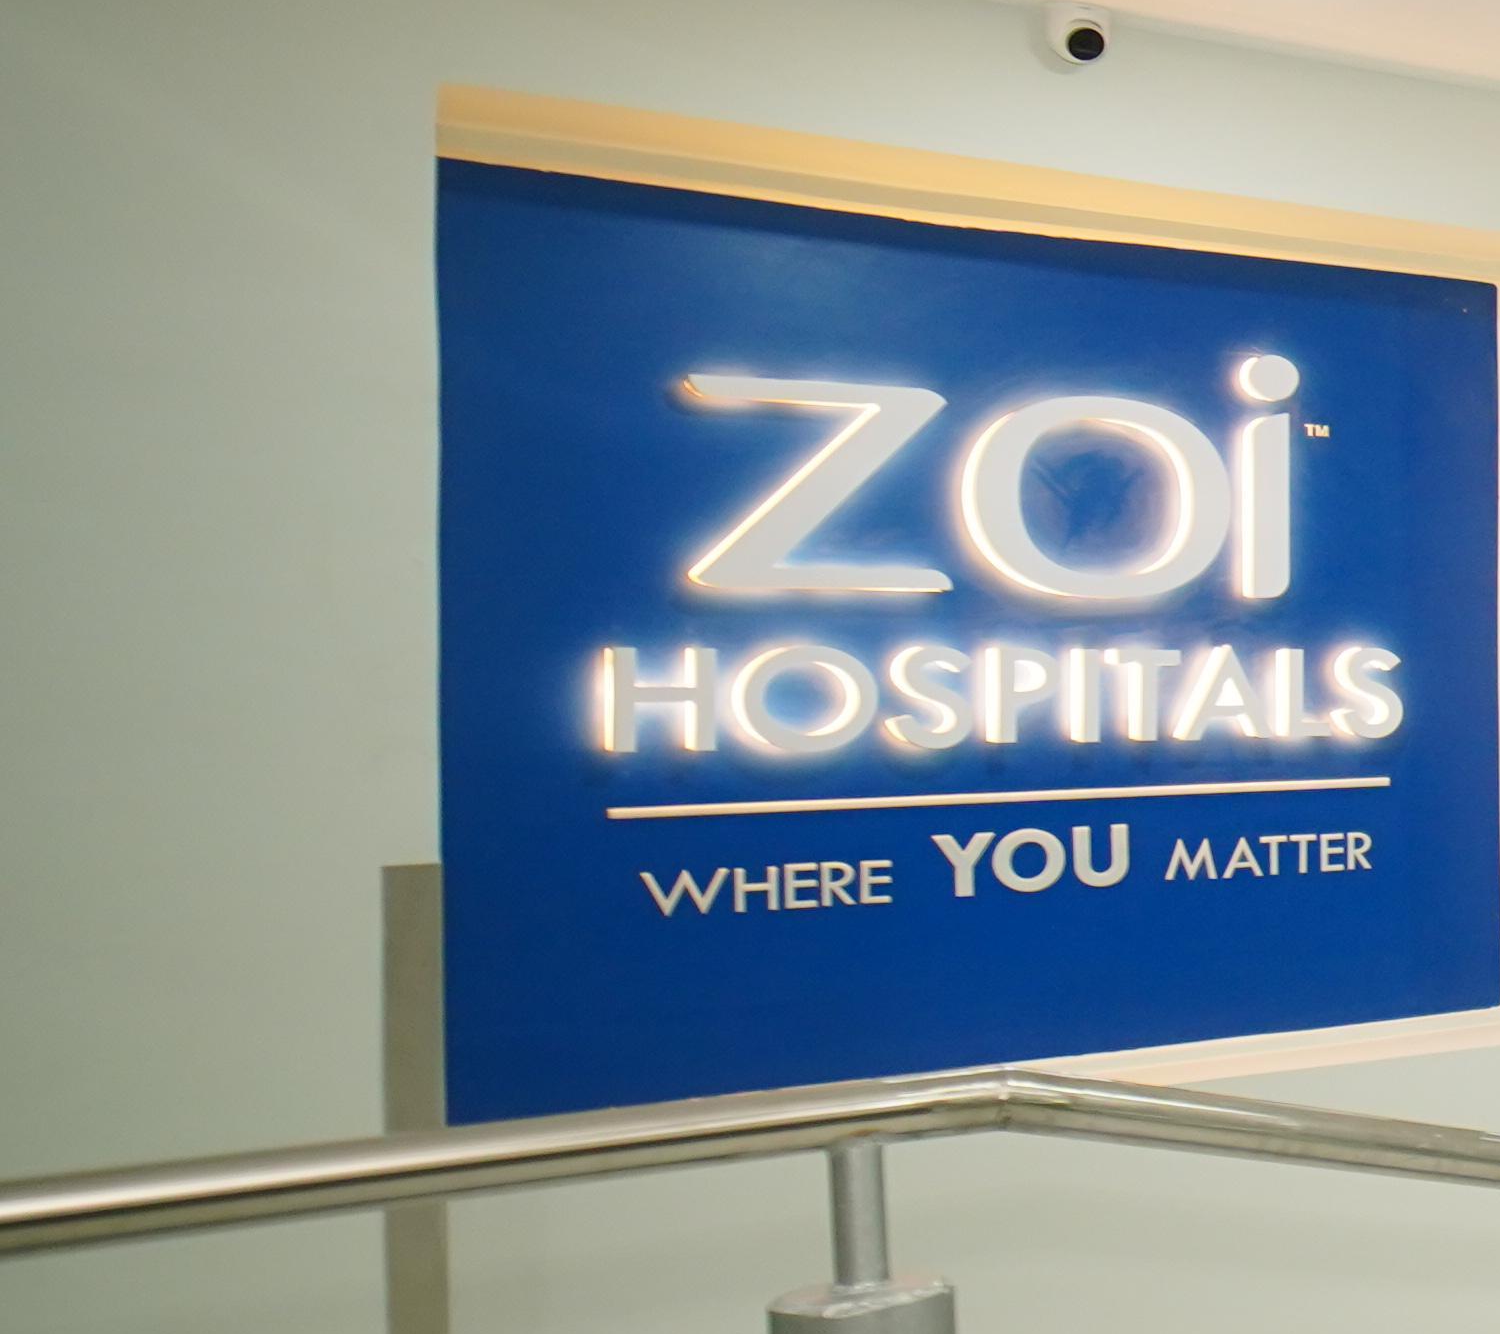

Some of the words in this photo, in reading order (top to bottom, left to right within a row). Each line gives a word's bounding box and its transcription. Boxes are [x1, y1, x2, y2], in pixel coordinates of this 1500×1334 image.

[603, 645, 1404, 753] HOSPITALS
[640, 859, 893, 917] WHERE
[931, 823, 1130, 898] YOU
[1164, 831, 1373, 881] MATTER
